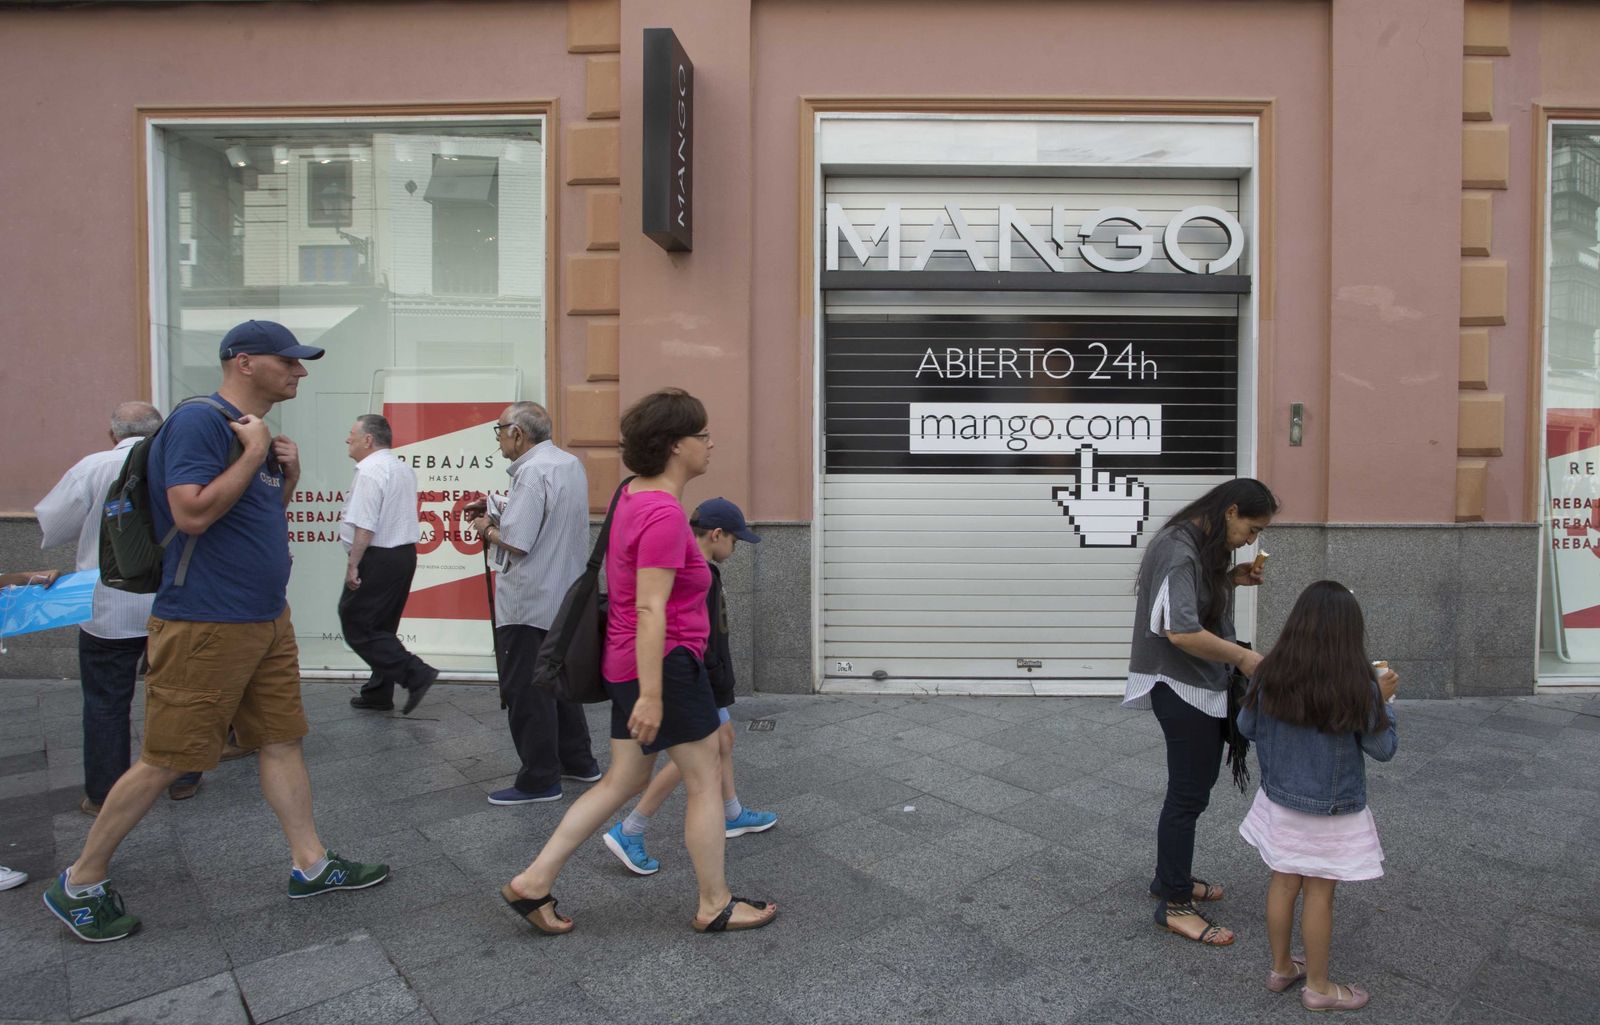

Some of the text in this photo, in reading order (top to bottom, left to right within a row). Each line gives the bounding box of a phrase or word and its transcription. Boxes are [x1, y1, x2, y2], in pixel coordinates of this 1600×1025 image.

[677, 63, 686, 228] MANGO
[825, 202, 1245, 275] MANGO
[914, 341, 1158, 380] ABIERTO 24h
[920, 414, 1151, 452] mango.com
[290, 491, 349, 503] EBAJA
